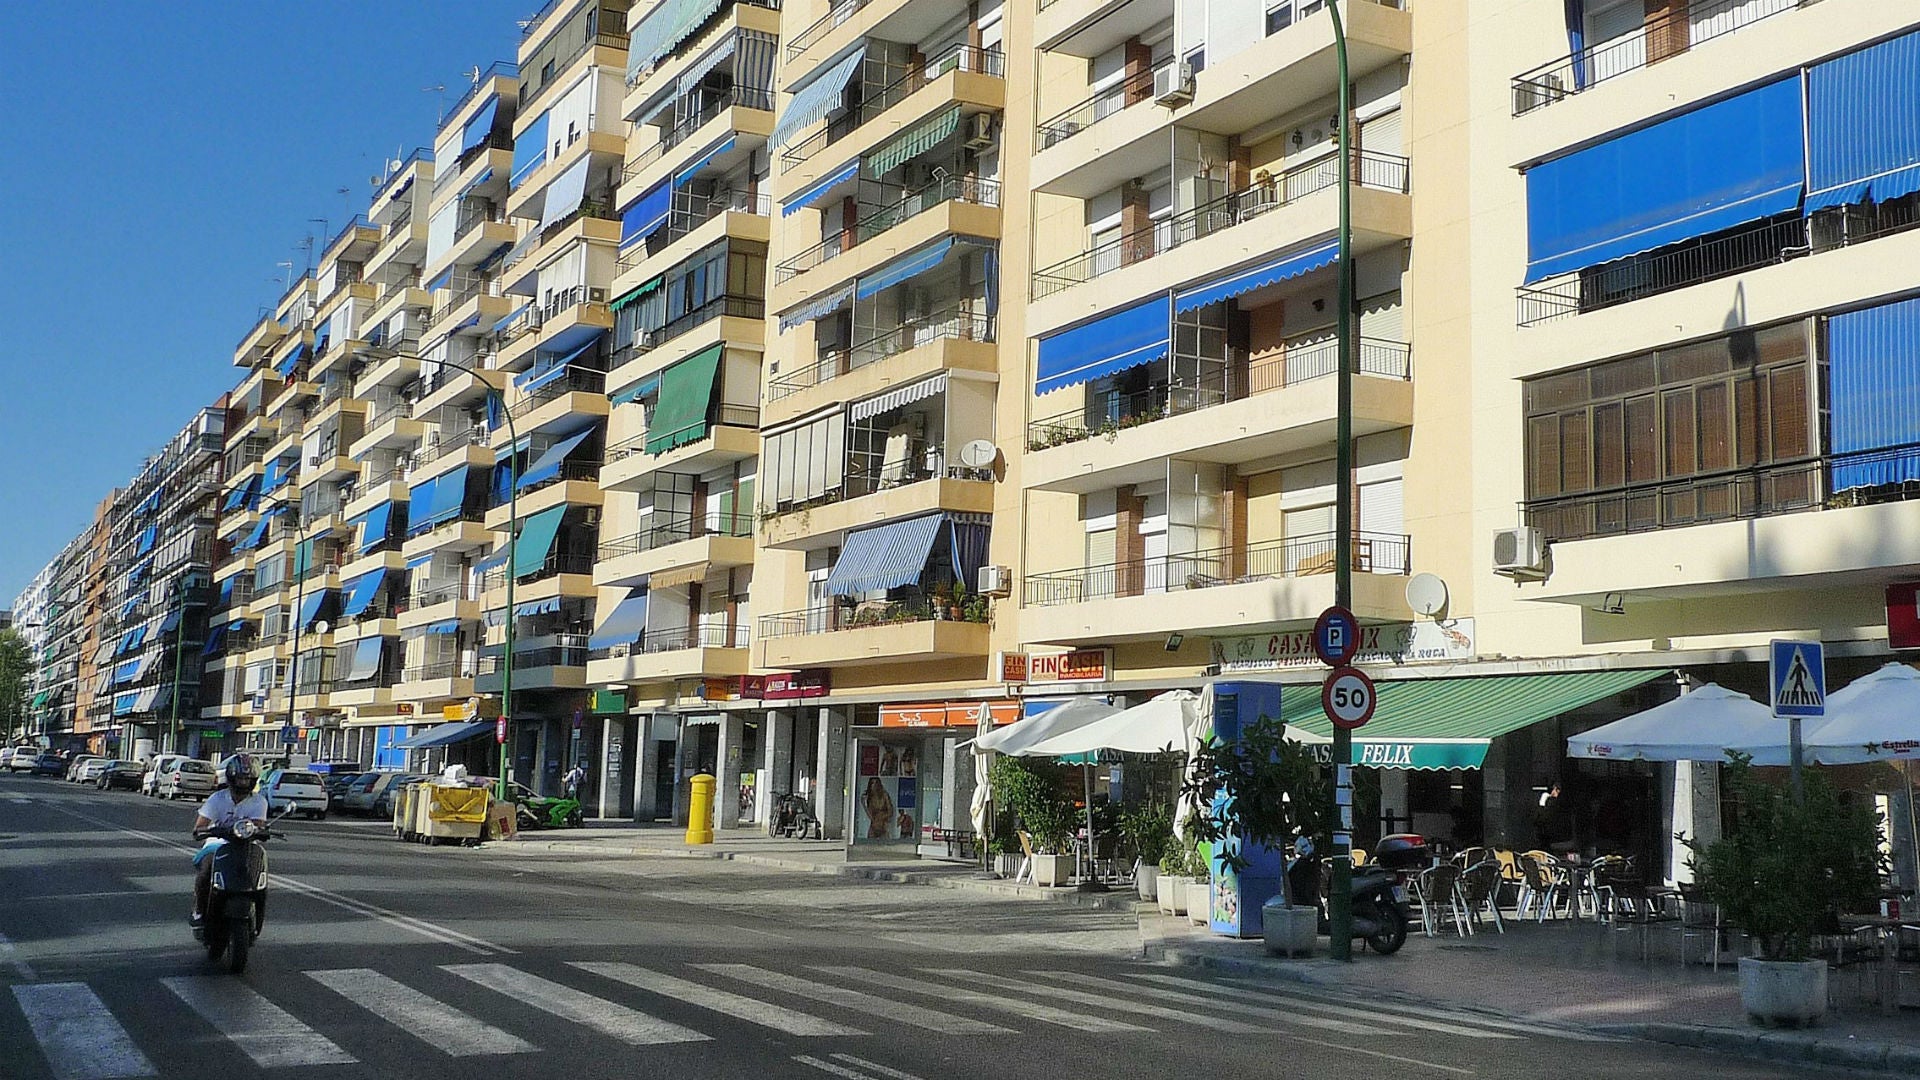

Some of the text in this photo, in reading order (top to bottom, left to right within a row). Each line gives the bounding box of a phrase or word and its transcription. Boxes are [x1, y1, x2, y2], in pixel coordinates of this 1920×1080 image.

[1268, 632, 1314, 655] CASA
[1330, 629, 1339, 645] P
[1005, 656, 1026, 665] FIN
[1005, 666, 1026, 674] CASH
[1334, 687, 1365, 708] 50
[1360, 744, 1414, 764] FELIX
